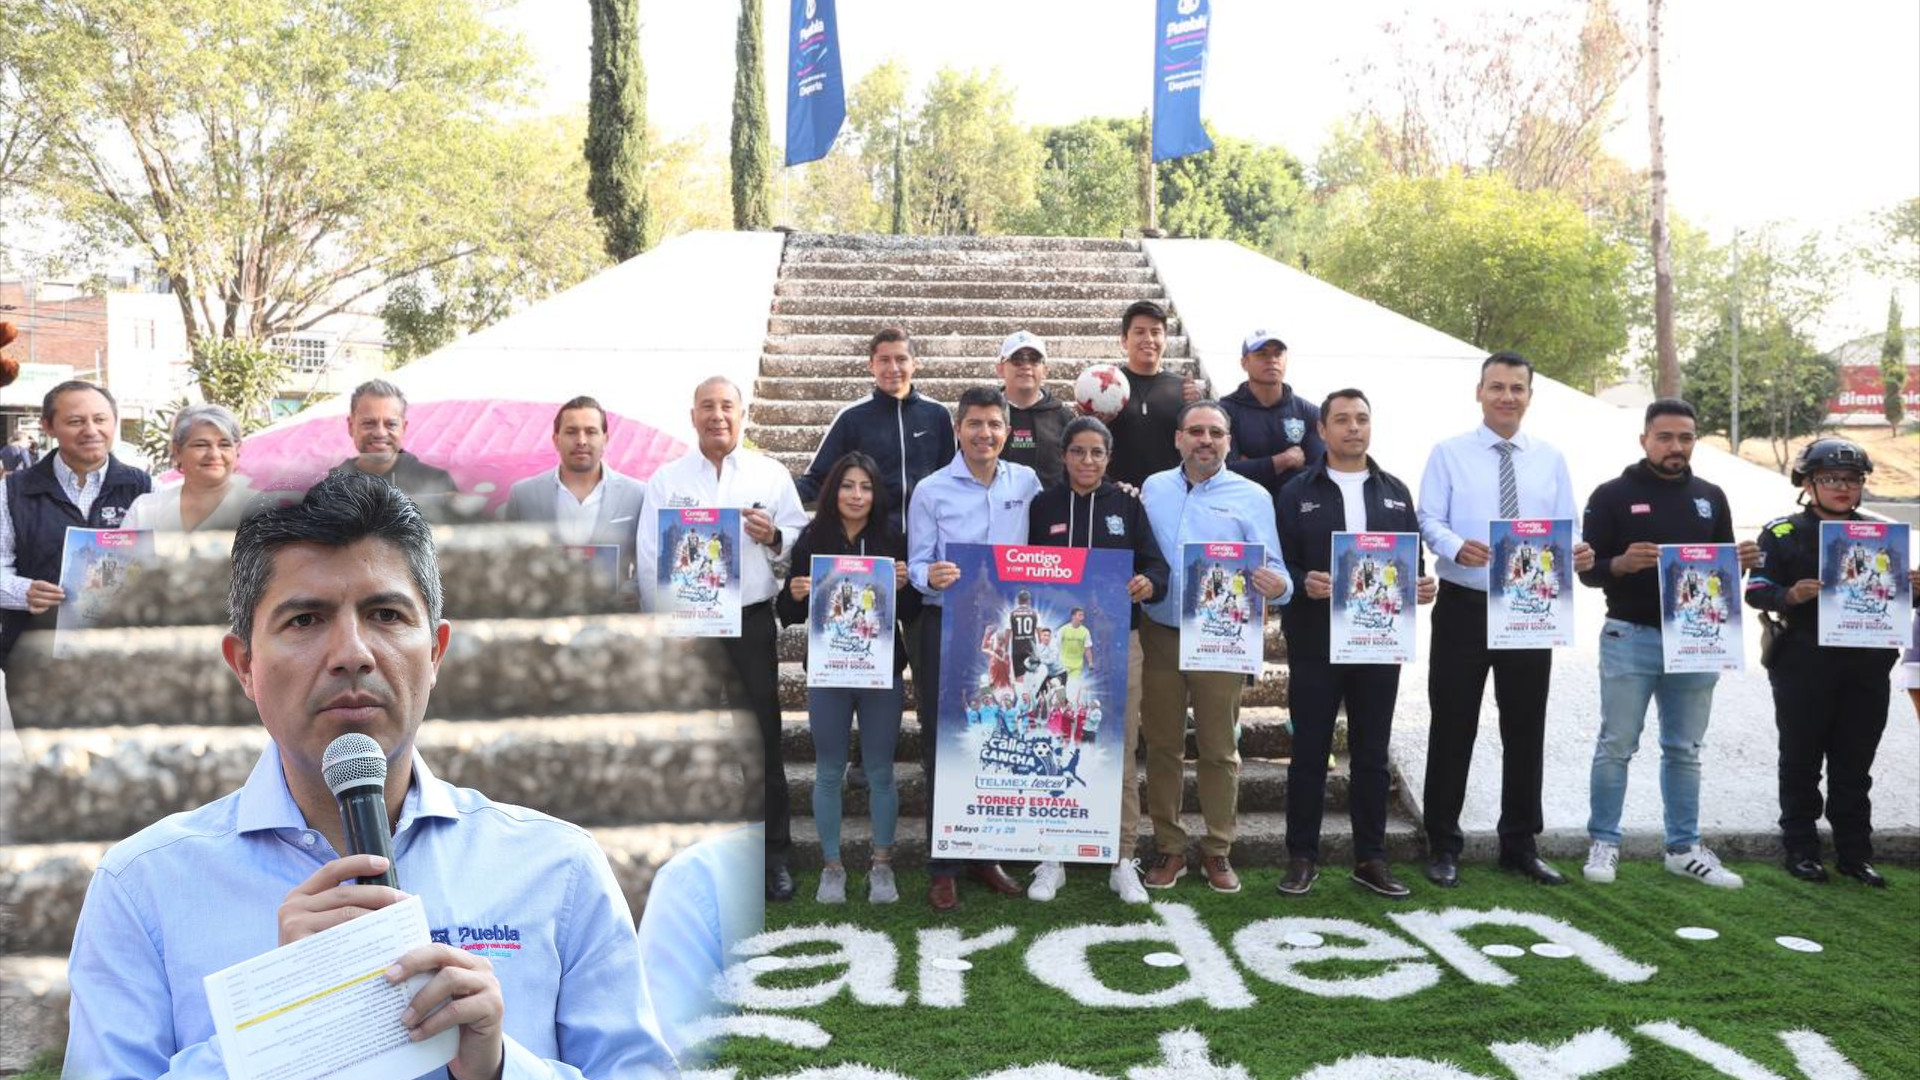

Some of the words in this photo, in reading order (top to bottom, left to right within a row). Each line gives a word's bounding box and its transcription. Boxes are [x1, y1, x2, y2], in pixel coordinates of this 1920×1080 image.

[1006, 548, 1062, 567] Contigo
[1026, 564, 1073, 579] rumbo
[1015, 617, 1033, 634] 10
[981, 749, 1036, 767] CANCHA
[979, 778, 1028, 788] TELMEX
[977, 796, 1025, 806] TORNEO
[1029, 796, 1080, 808] ESTATAL
[966, 804, 1024, 817] STREET
[1029, 806, 1090, 819] SOCCER
[954, 825, 980, 834] Mayo
[982, 826, 994, 834] 27
[458, 924, 521, 943] Puebla
